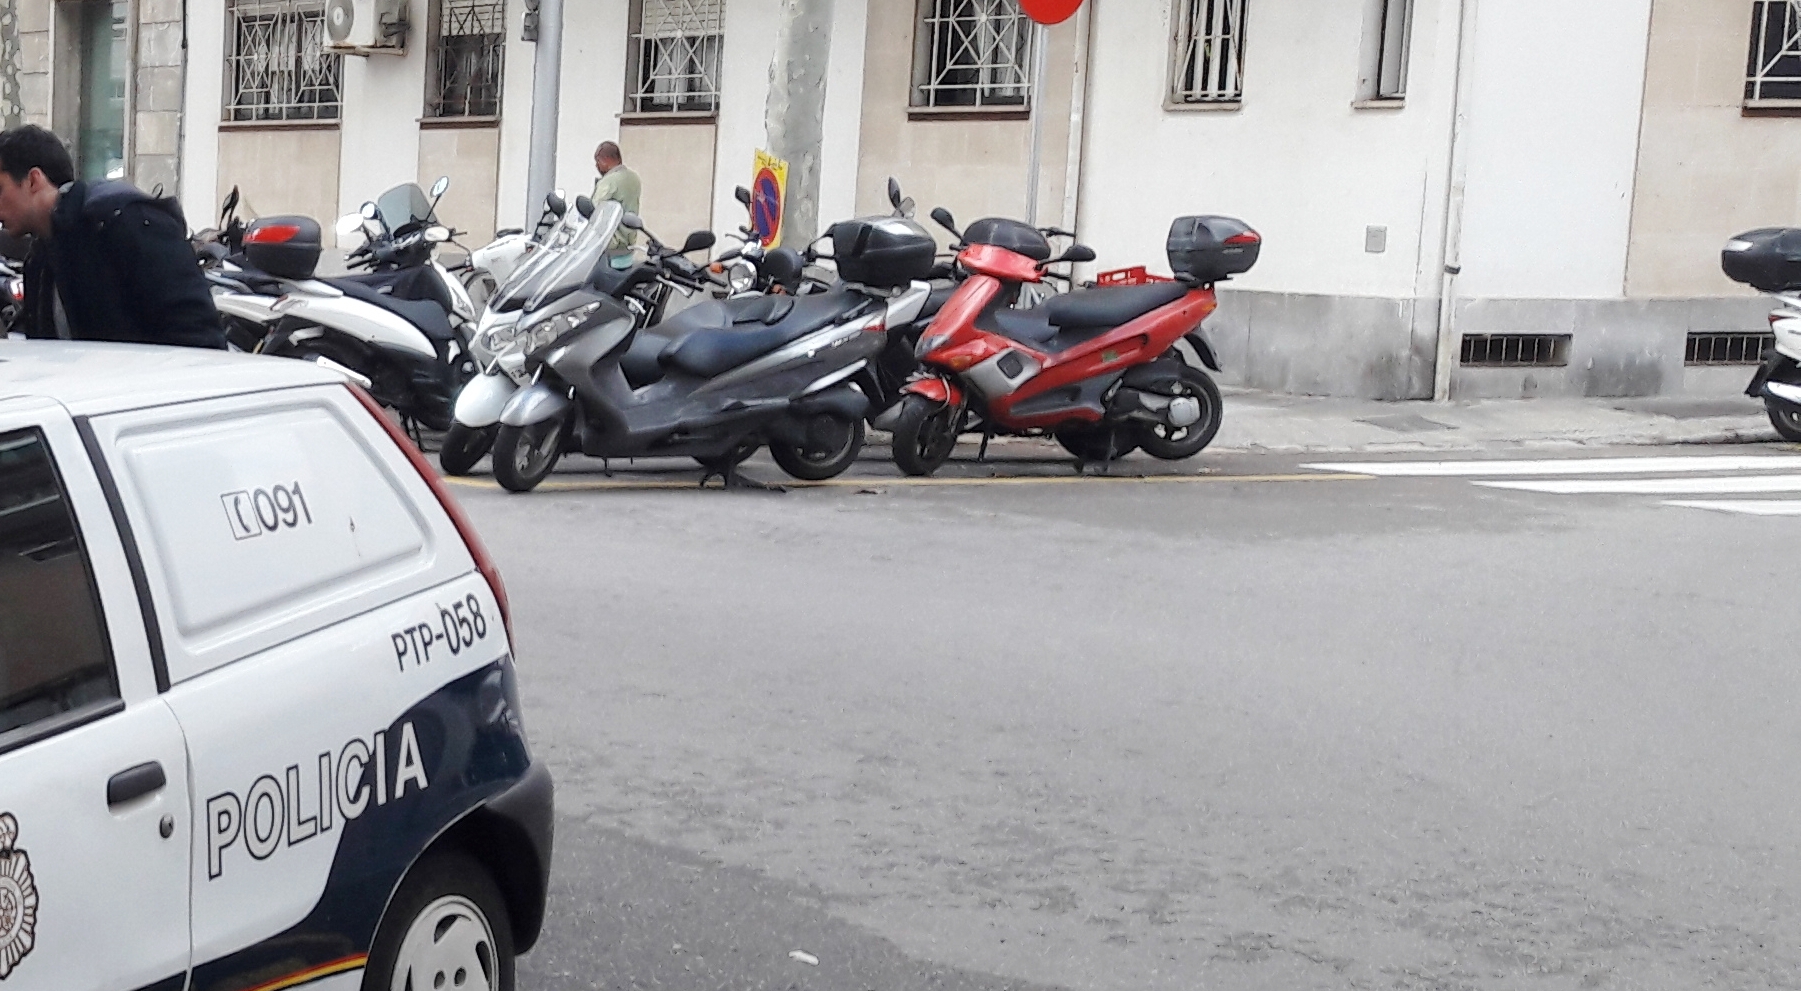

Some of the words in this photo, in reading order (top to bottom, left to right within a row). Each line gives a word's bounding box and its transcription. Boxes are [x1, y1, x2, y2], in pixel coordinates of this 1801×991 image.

[253, 479, 312, 532] 091
[390, 593, 488, 673] PTP-058
[206, 720, 430, 882] POLICIA
